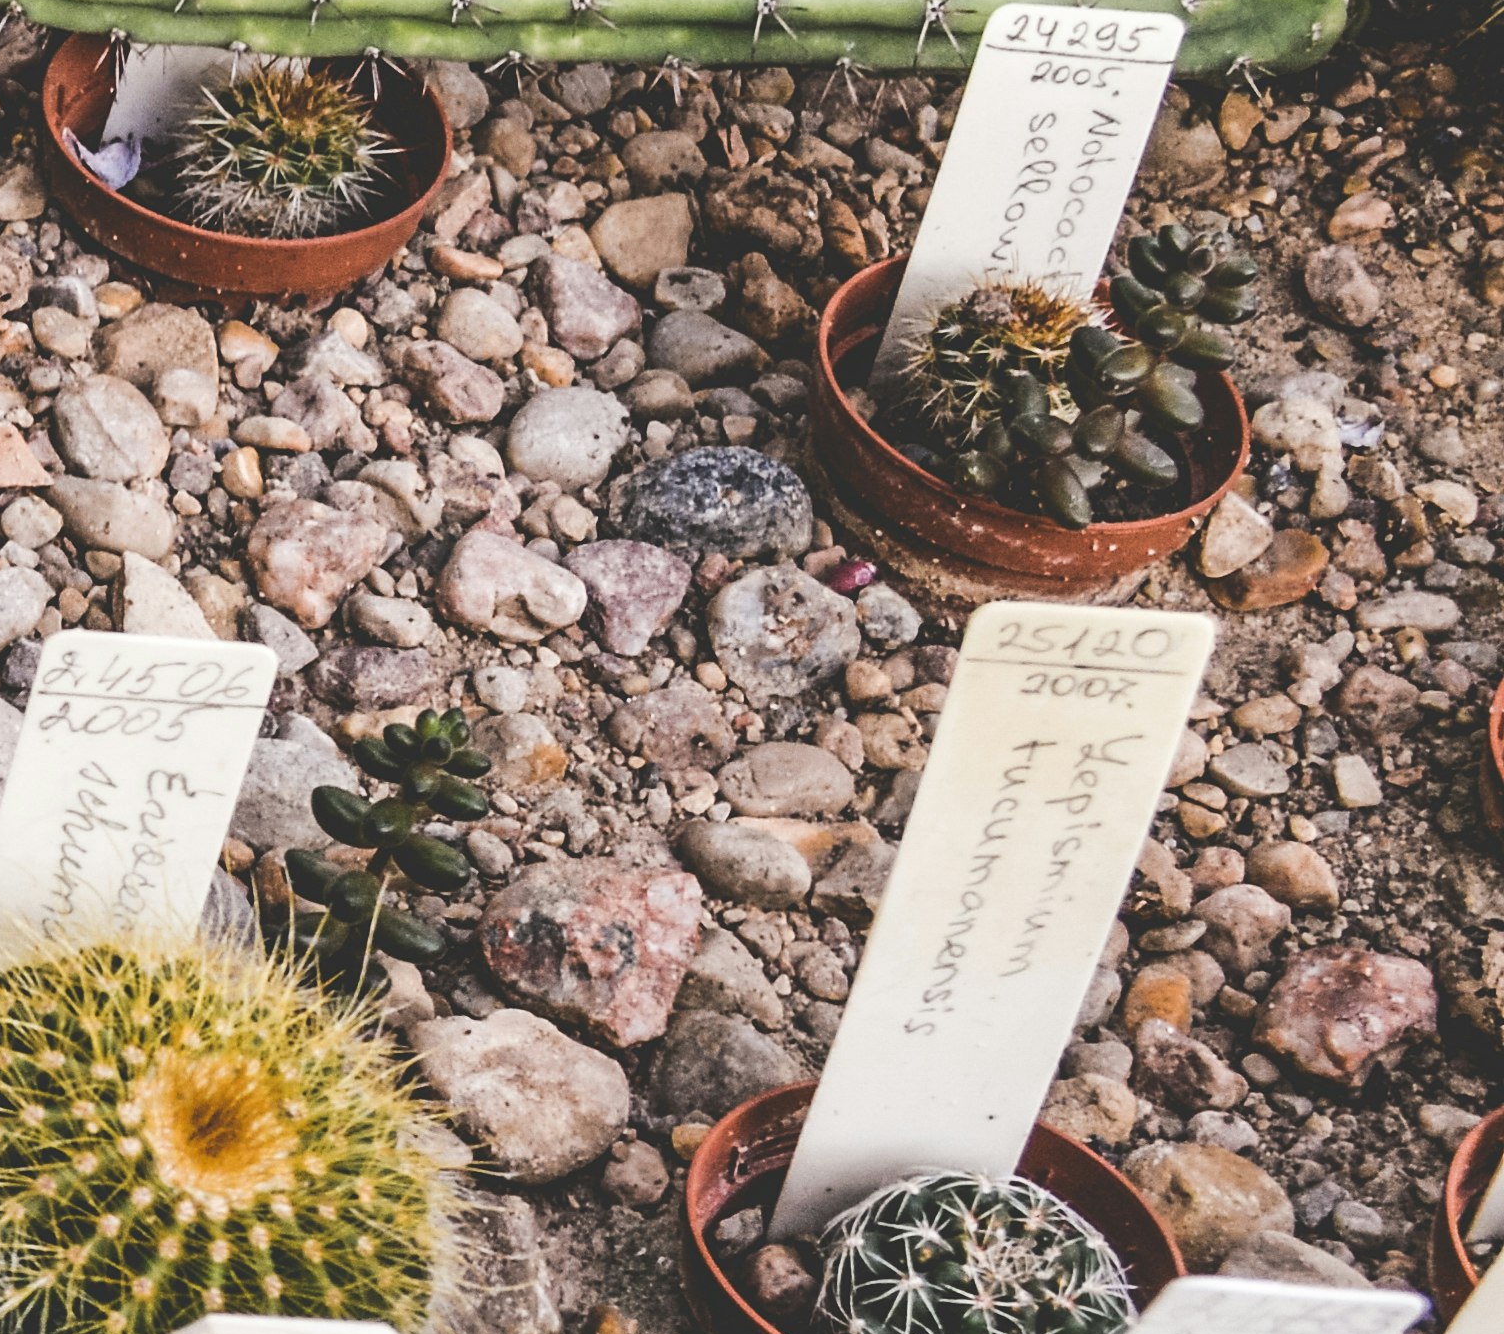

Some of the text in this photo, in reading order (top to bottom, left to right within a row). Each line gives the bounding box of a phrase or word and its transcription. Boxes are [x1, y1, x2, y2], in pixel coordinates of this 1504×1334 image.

[1004, 12, 1160, 55] 24295
[1028, 58, 1124, 99] 2005.
[1035, 107, 1122, 281] Notocac
[995, 620, 1173, 661] 25120
[35, 648, 256, 704] 24506
[1017, 670, 1139, 711] 2007.
[35, 698, 225, 744] 2005
[900, 736, 1059, 1037] tucumanensis
